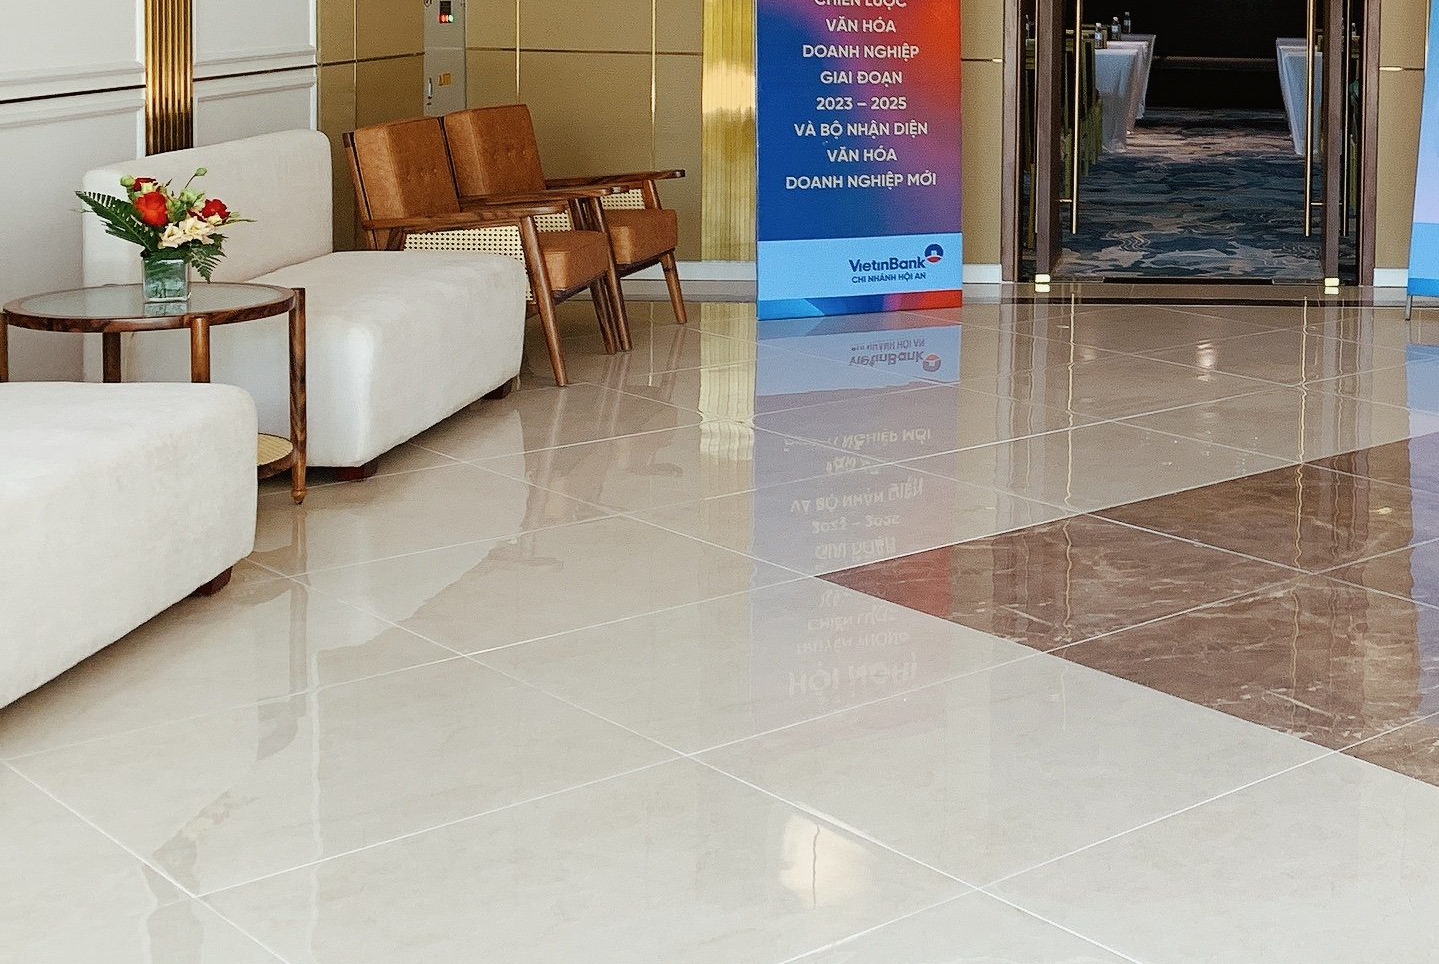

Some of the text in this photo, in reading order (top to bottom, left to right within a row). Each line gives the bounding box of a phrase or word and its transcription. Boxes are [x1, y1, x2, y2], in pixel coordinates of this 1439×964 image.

[826, 16, 896, 33] VĂN HÓA
[802, 43, 920, 62] DOANH NGHIỆP
[820, 71, 903, 87] GIAI ĐOẠN
[816, 97, 853, 110] 2023
[870, 97, 907, 110] 2025
[794, 119, 928, 140] VÀ BỘ NHẬN DIỆN
[826, 145, 898, 162] VĂN HÓA
[785, 170, 937, 190] DOANH NGHIỆP MỚI
[849, 255, 926, 273] VietinBank
[851, 271, 926, 284] CHI NHÁNH HỘI AN
